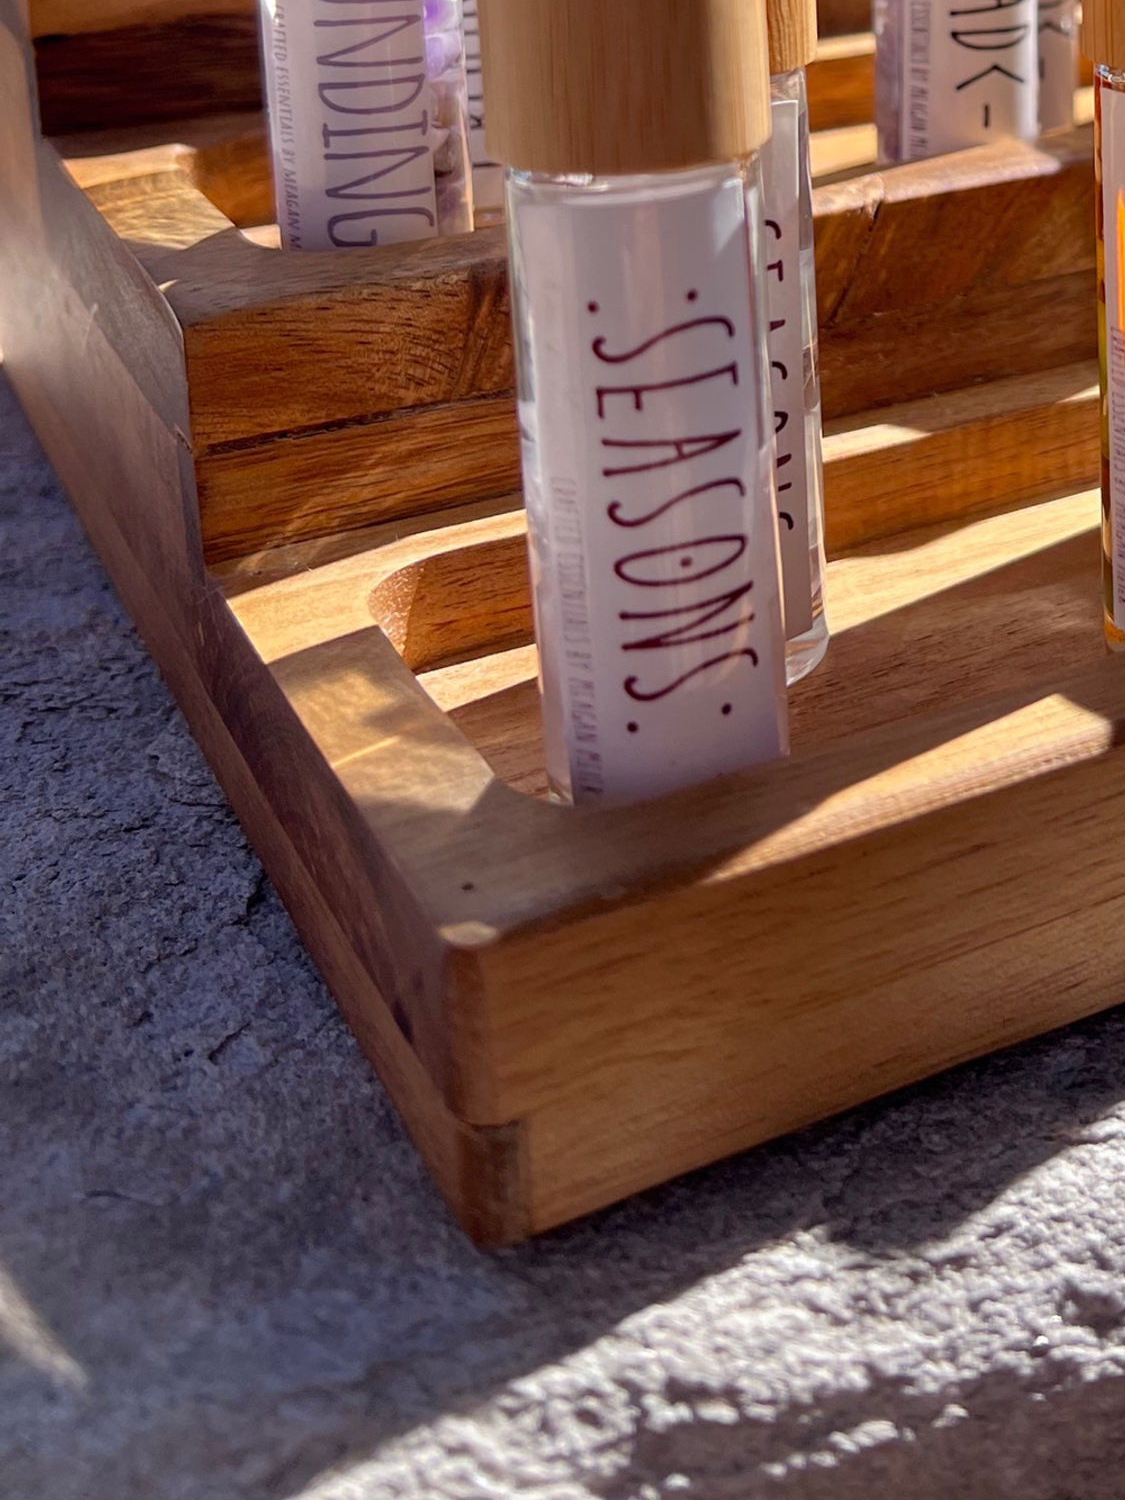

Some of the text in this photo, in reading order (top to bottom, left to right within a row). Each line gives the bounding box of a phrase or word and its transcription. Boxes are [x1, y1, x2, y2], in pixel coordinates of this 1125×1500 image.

[275, 65, 295, 144] ESSENTIALS
[281, 147, 297, 164] BY
[283, 167, 301, 230] MEAGAN
